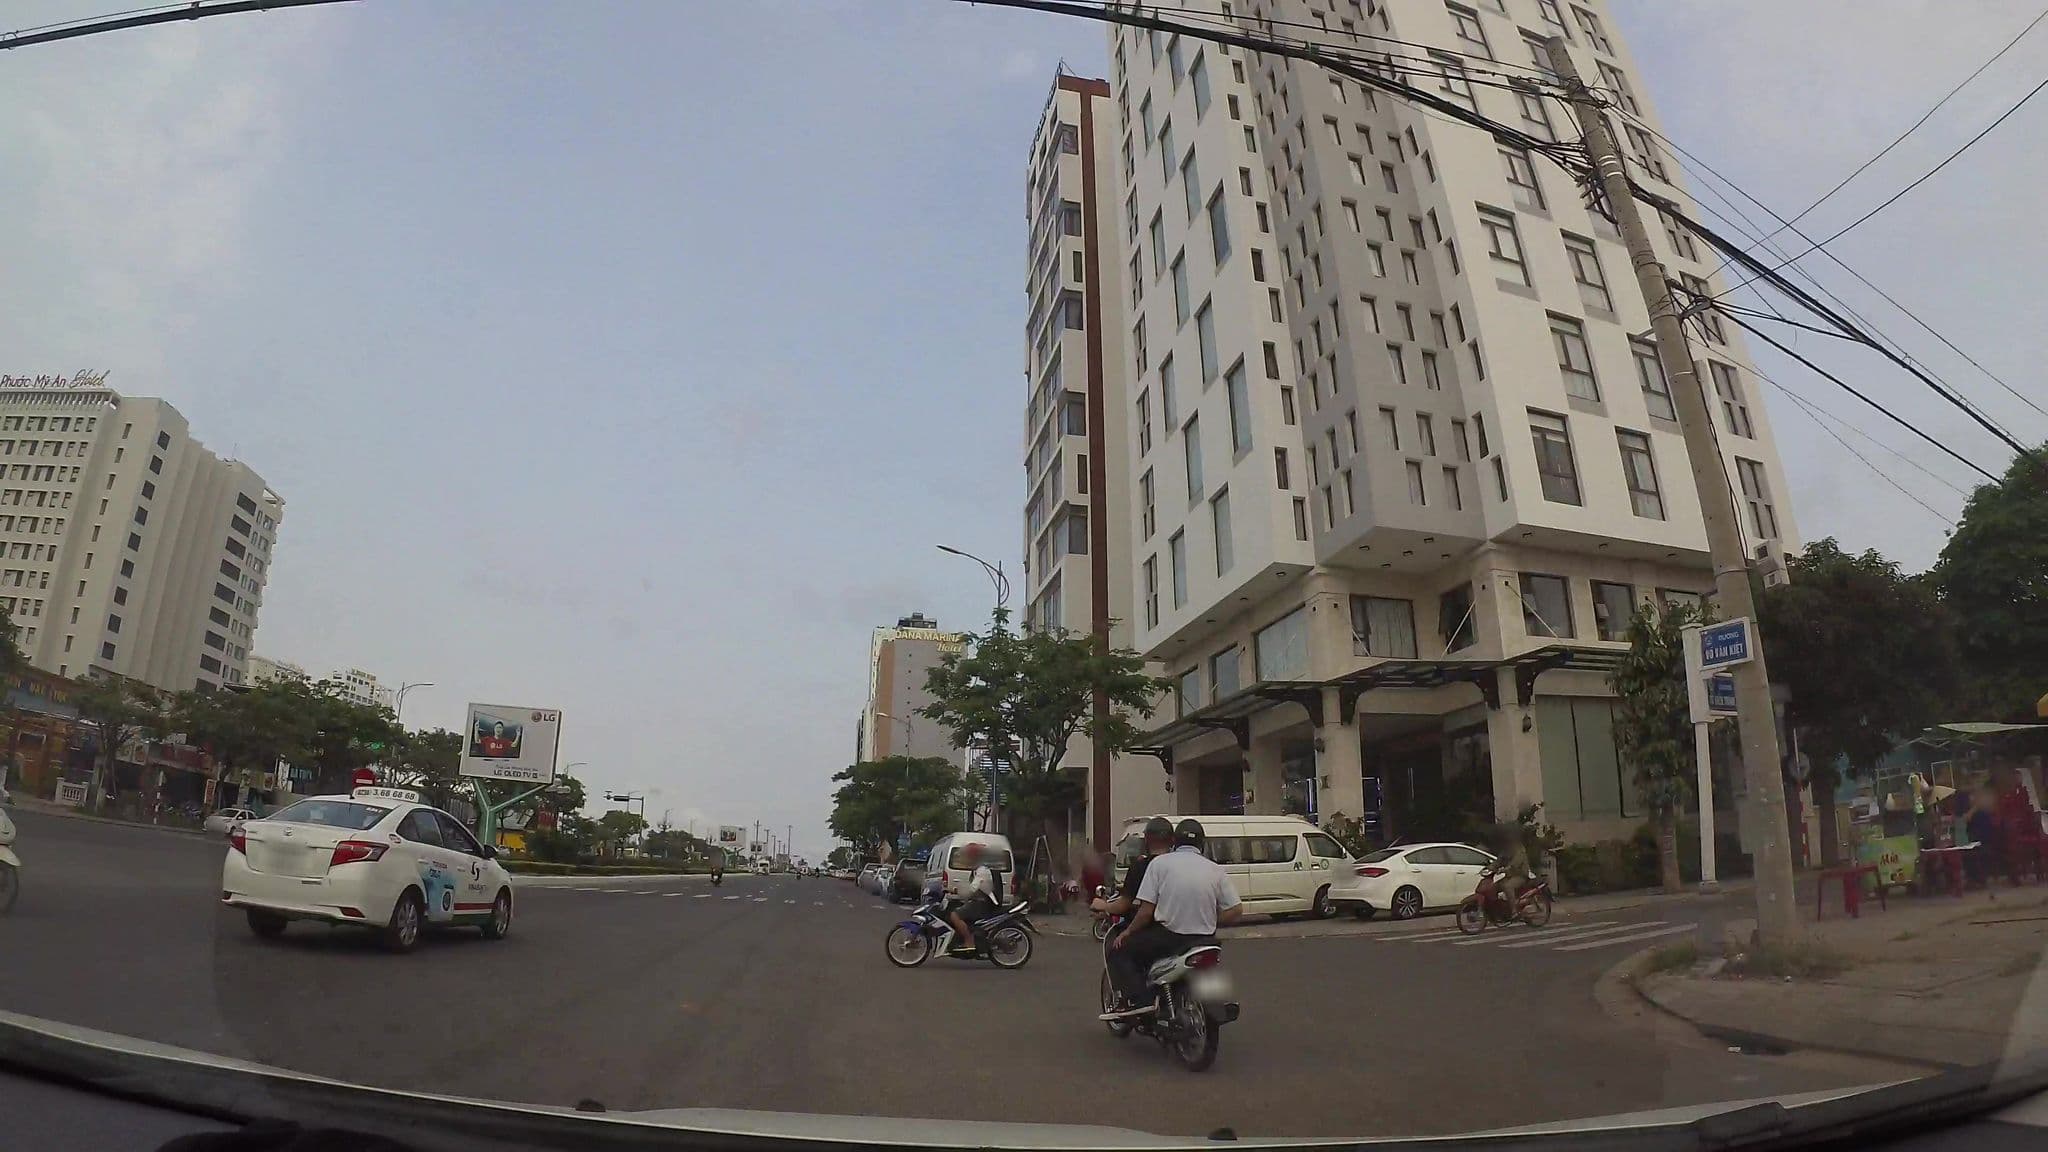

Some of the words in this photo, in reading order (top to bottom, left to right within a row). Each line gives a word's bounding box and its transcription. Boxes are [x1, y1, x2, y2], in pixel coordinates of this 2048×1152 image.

[896, 631, 922, 641] DANA
[543, 713, 556, 722] LG
[494, 769, 503, 777] LG
[504, 770, 521, 778] OLED
[522, 771, 533, 779] TV
